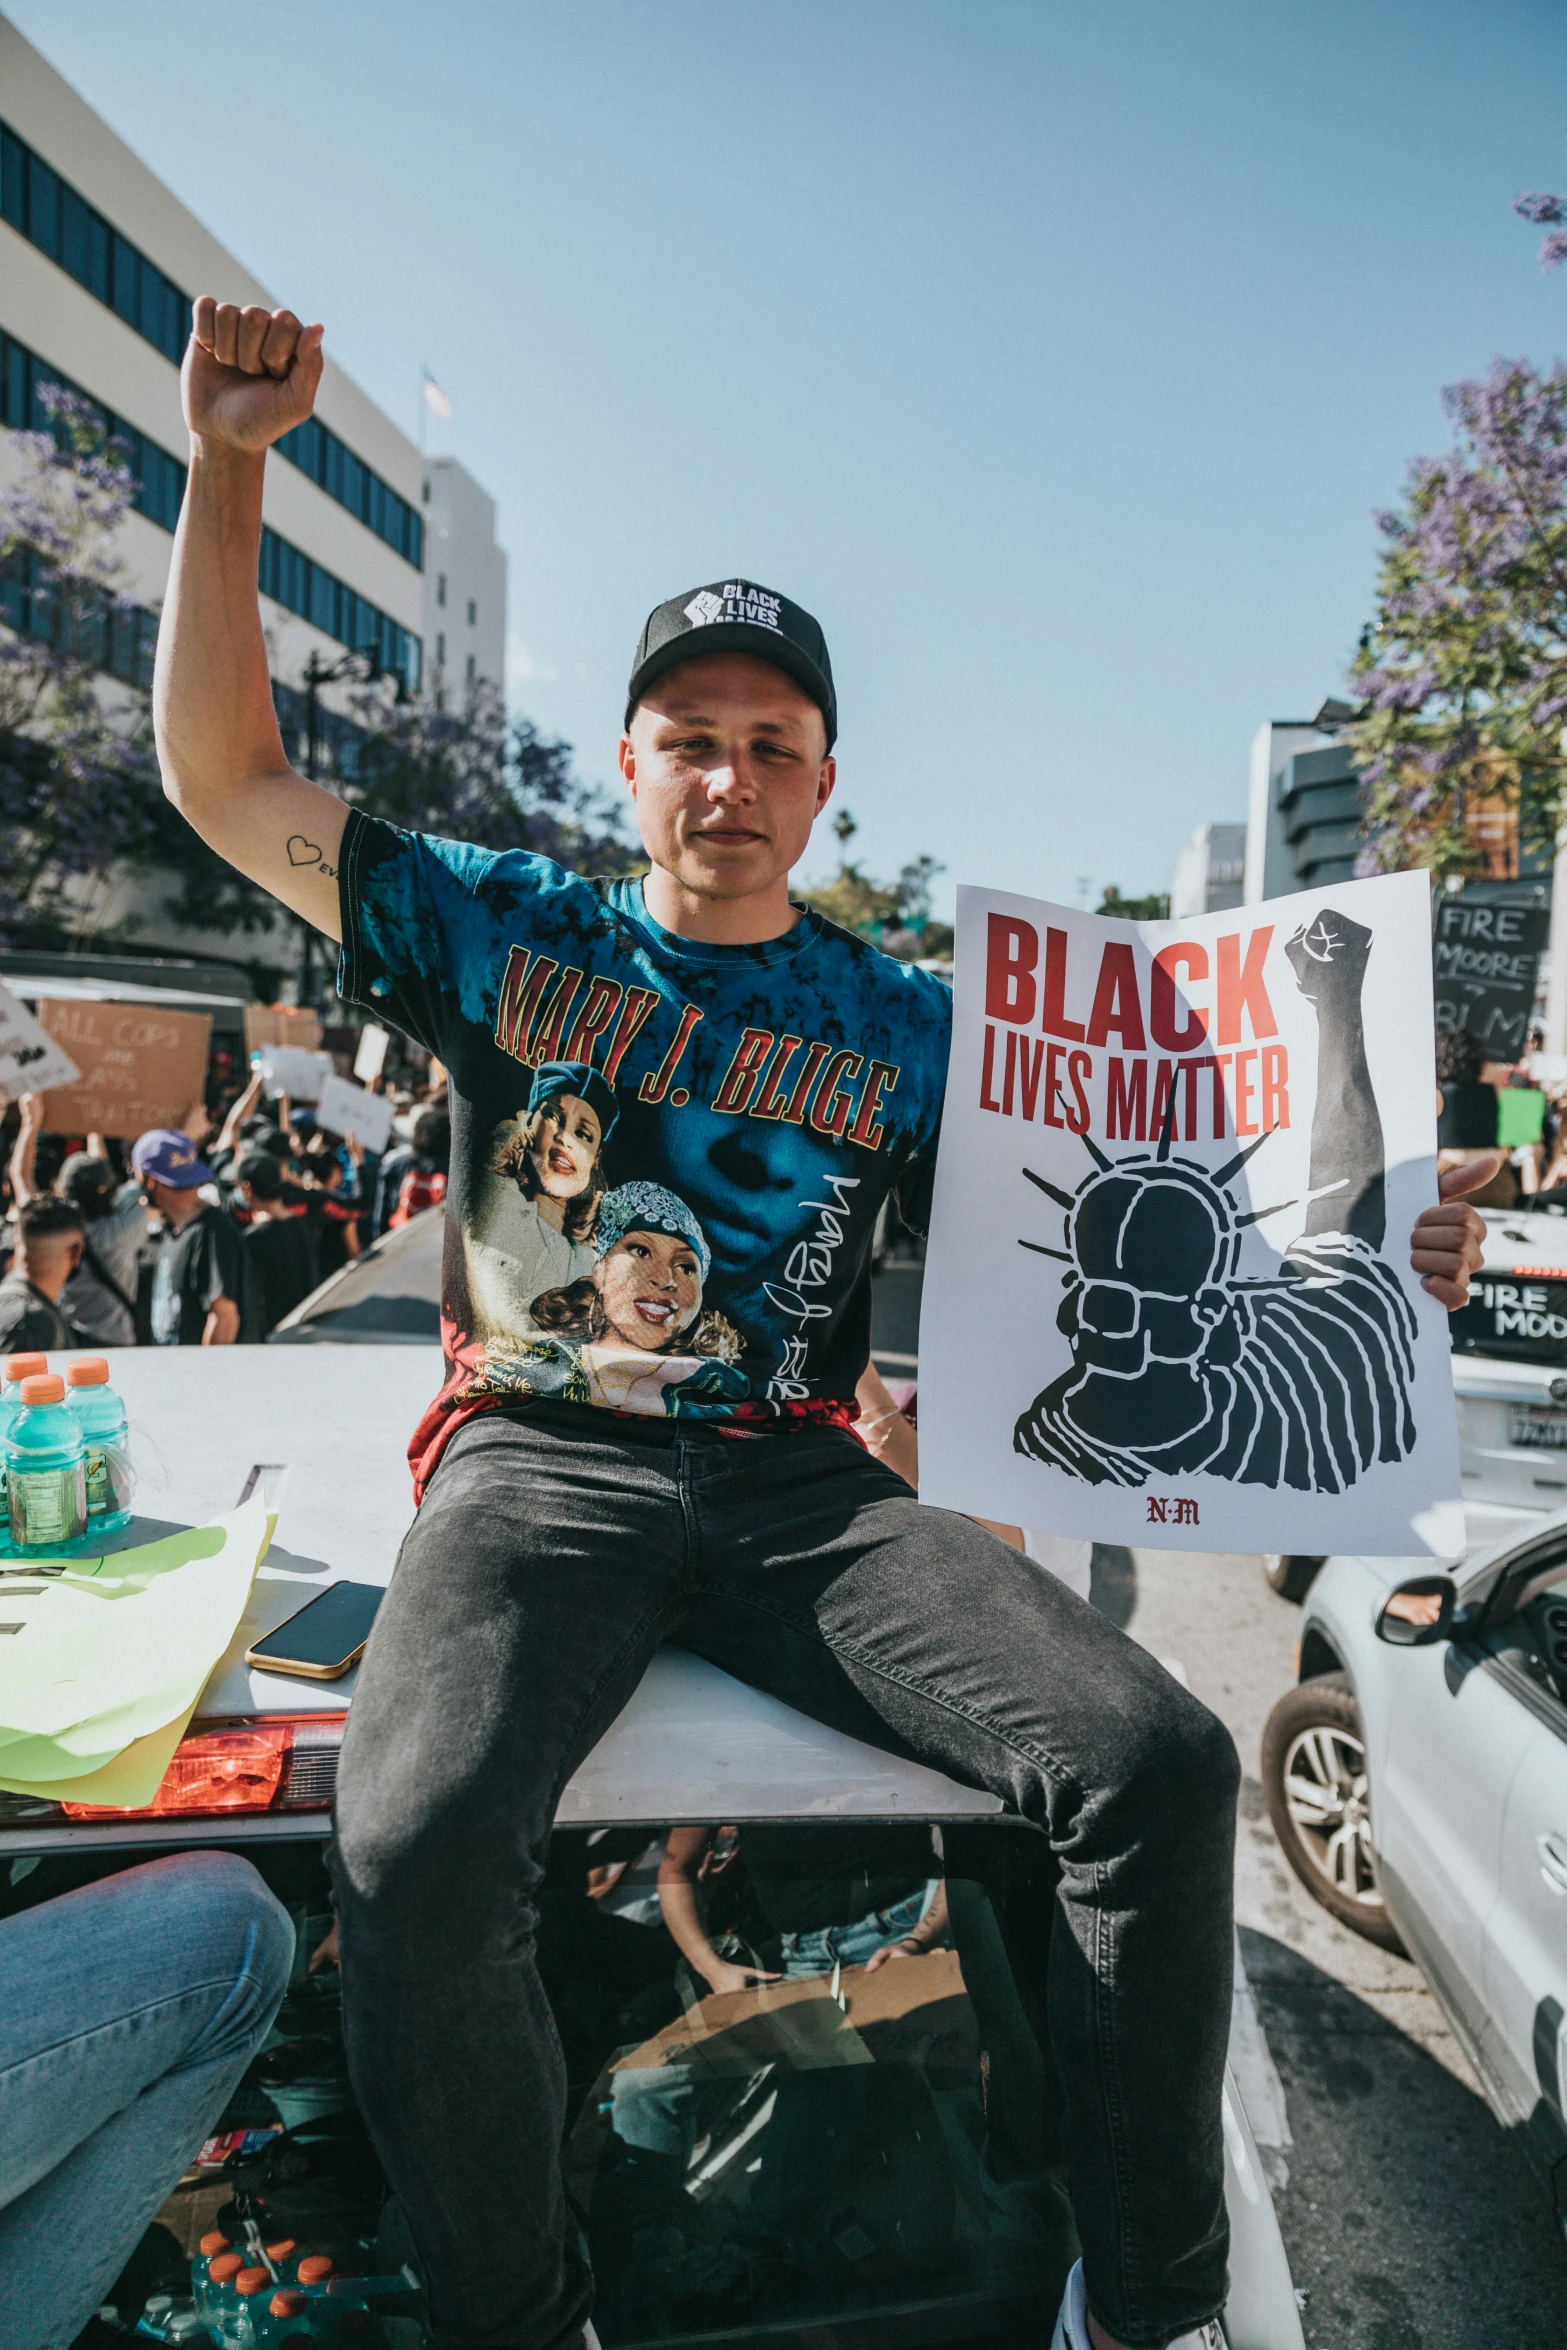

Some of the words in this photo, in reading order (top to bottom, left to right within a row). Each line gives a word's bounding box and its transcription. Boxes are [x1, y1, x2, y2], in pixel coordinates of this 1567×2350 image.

[723, 584, 781, 612] BLACK
[727, 600, 778, 627] LIVES
[319, 863, 339, 881] EV
[1441, 907, 1526, 942] FIRE
[1435, 941, 1535, 981] MOORE
[984, 911, 1279, 1052] BLACK
[494, 943, 661, 1090] MARY
[637, 1002, 705, 1107] J.
[710, 1026, 901, 1151] BLIGE
[979, 1024, 1093, 1136] LIVES
[1106, 1043, 1290, 1143] MATTER
[1465, 1283, 1548, 1312] FIRE
